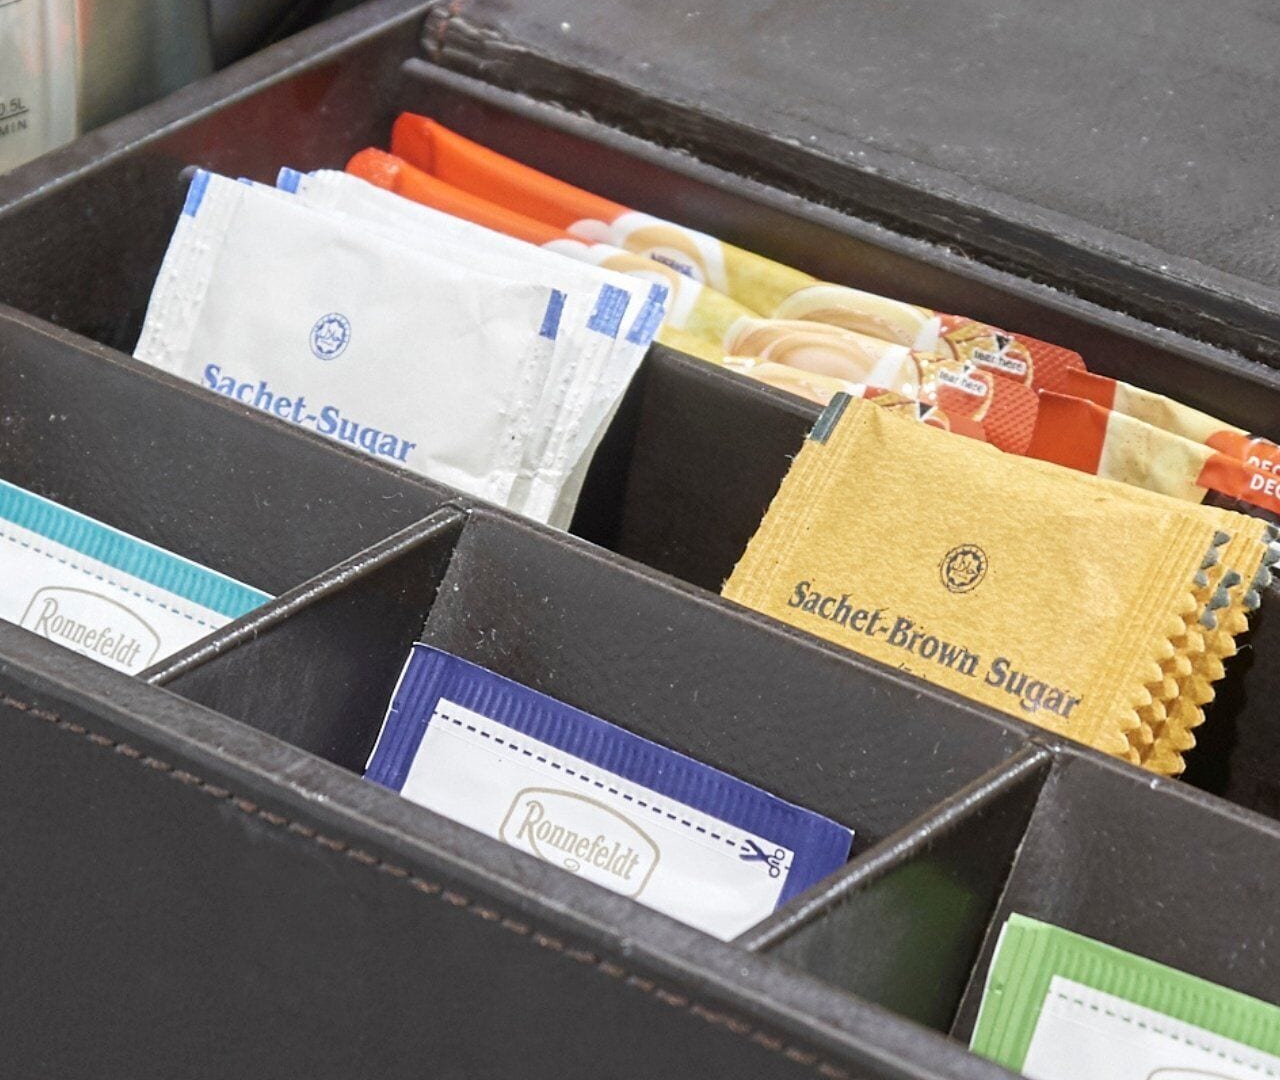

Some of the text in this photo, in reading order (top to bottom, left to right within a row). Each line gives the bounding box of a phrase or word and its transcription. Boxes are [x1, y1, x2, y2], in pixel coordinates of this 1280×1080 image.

[203, 363, 417, 463] Sachet-Sugar
[33, 597, 142, 668] Ronnefeldt
[787, 580, 1084, 719] Sachet-Brown Sugar
[516, 799, 640, 881] Ronnefeldt
